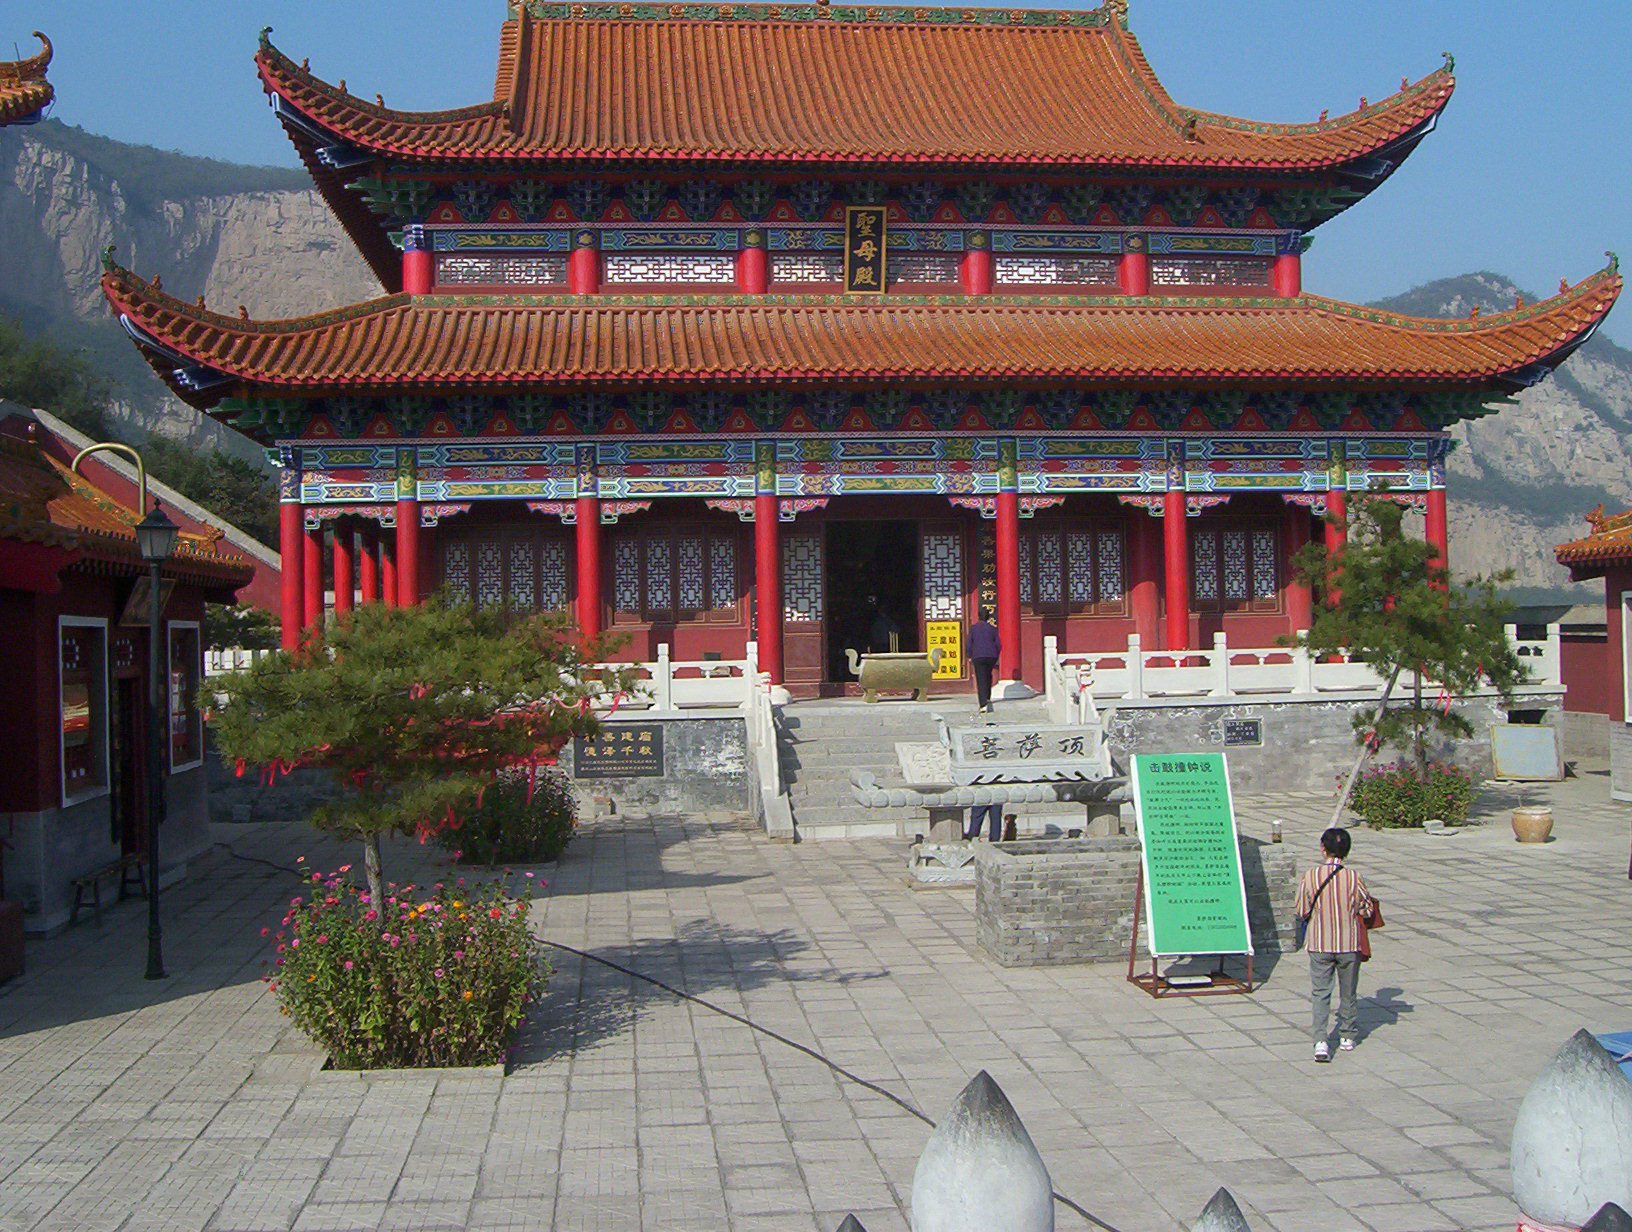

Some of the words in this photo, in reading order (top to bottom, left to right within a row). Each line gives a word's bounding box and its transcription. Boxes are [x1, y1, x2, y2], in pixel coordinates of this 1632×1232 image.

[852, 212, 878, 286] 聖母殿
[974, 731, 1085, 759] 菩萨顶
